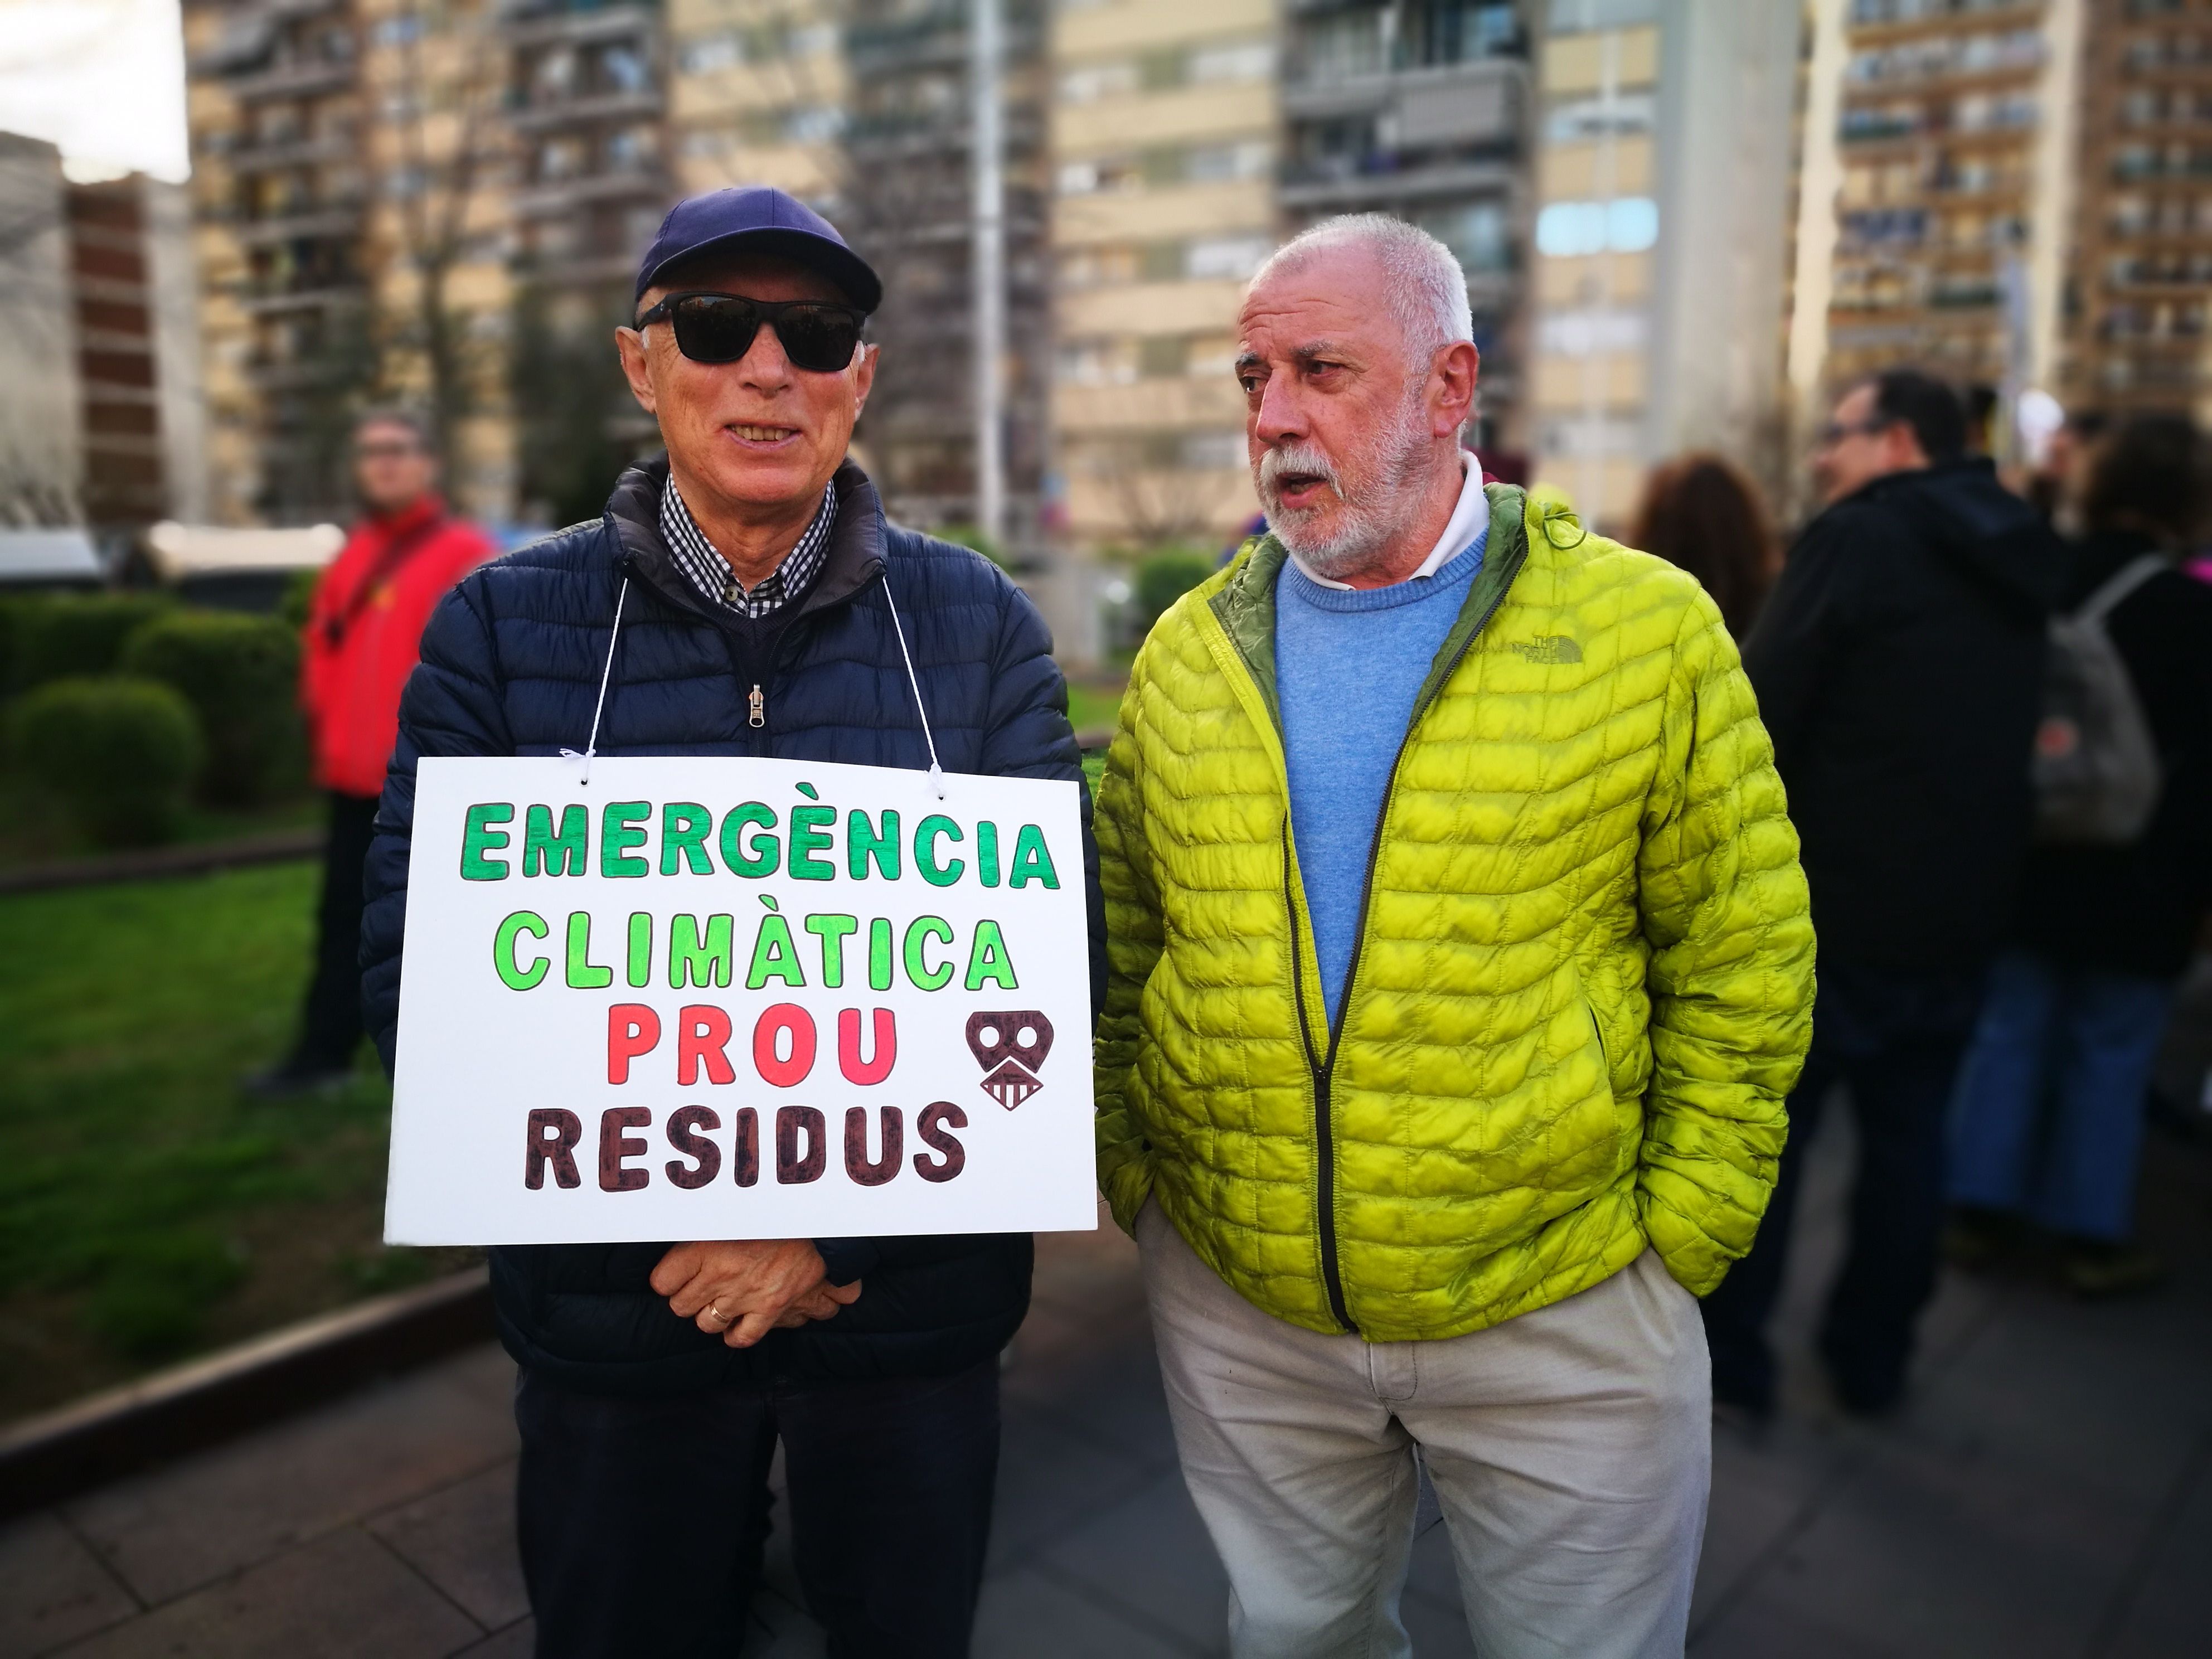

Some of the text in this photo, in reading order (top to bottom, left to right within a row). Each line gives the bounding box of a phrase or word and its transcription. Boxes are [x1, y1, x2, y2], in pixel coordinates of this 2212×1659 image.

[1525, 654, 1559, 664] FACE
[1532, 634, 1559, 647] THE
[460, 782, 1061, 890] EMERGÈNCIA
[493, 894, 1019, 992] CLIMÀTICA
[607, 1002, 897, 1088] PROU
[525, 1101, 968, 1192] RESIDUS
